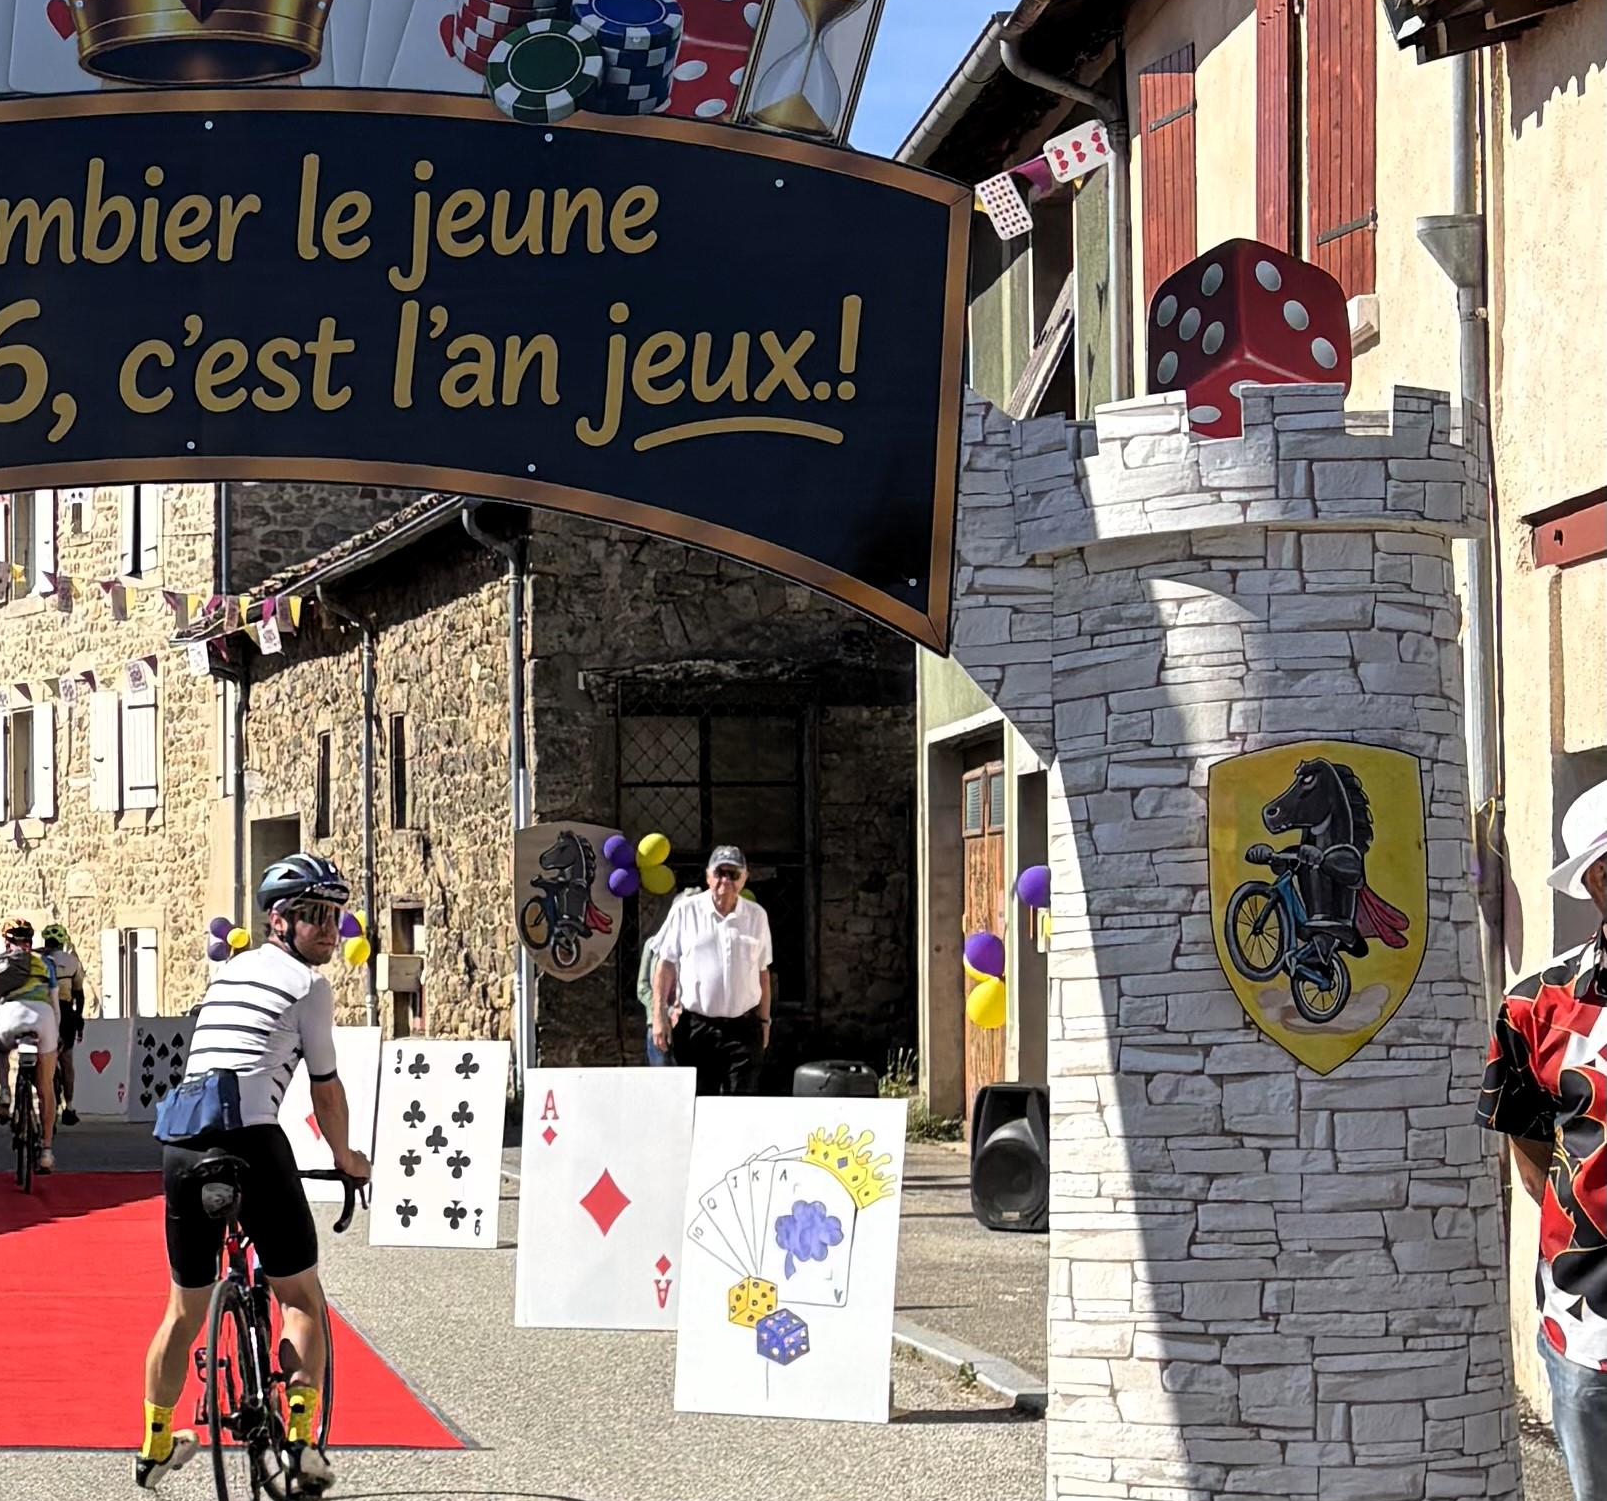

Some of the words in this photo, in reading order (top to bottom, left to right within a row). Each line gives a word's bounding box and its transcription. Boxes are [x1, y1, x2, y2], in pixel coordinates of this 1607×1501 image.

[297, 153, 372, 260] le
[388, 160, 659, 292] jeune
[119, 314, 355, 413] c'est
[393, 300, 560, 409] l'an
[540, 1089, 560, 1120] A
[751, 1169, 760, 1182] K
[707, 1197, 718, 1210] Q
[654, 1279, 673, 1309] A
